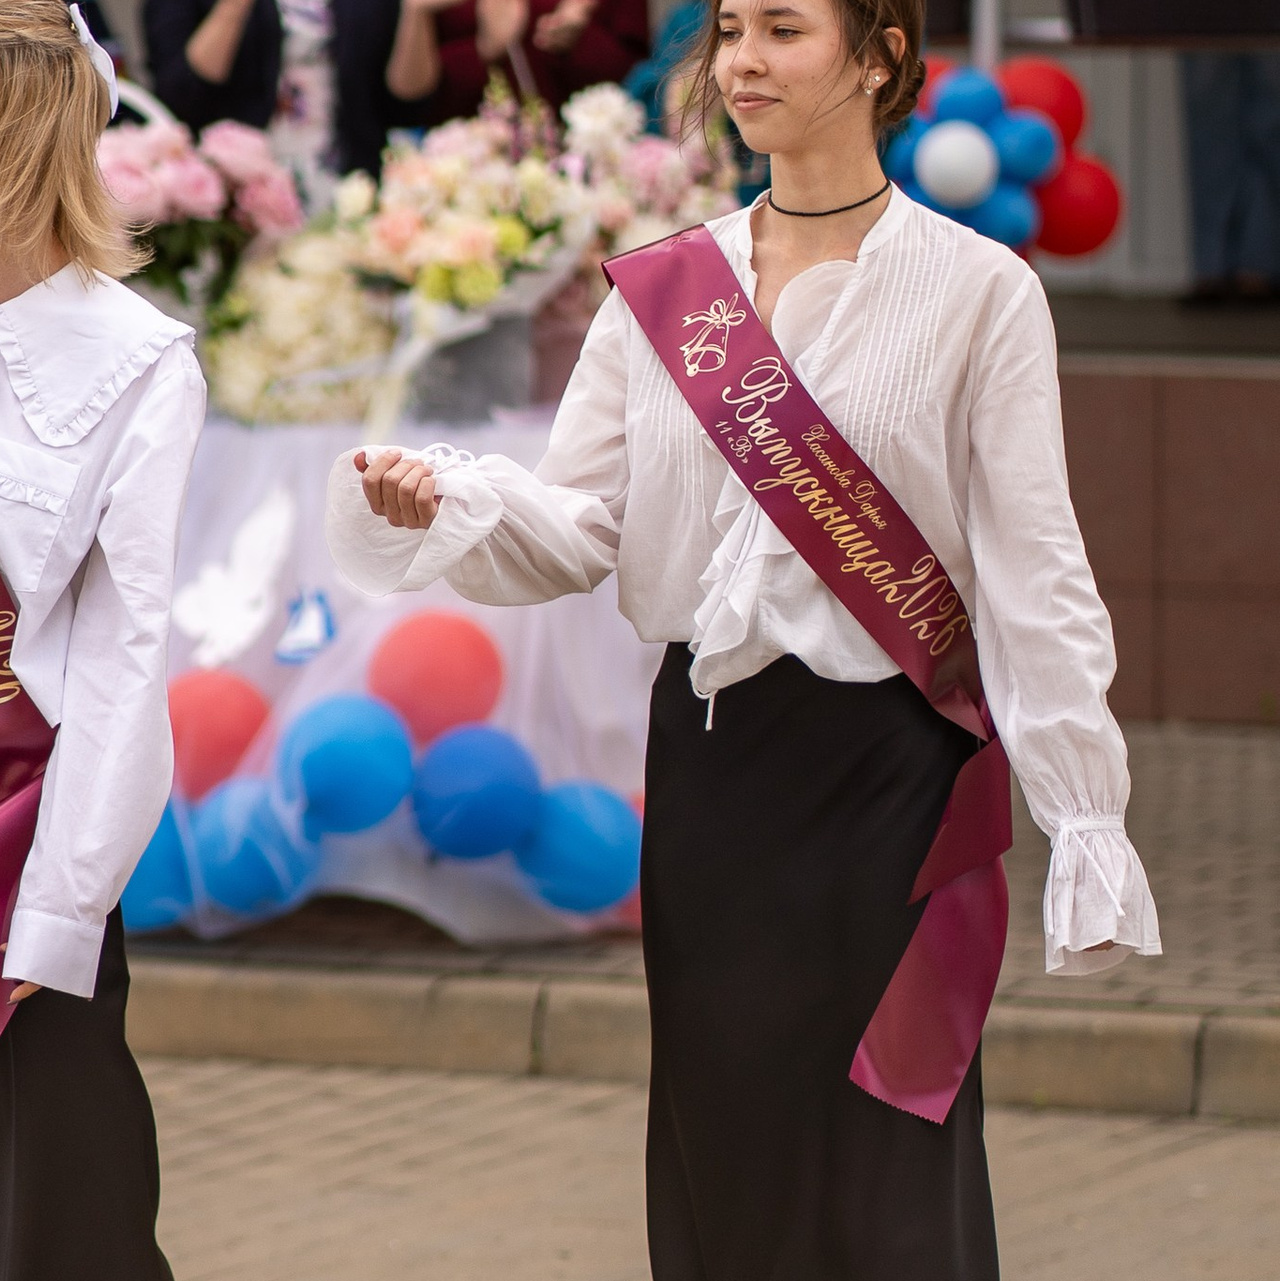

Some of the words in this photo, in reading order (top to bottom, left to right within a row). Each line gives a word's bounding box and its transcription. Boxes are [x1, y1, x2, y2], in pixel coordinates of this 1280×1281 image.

[715, 420, 733, 434] 11
[801, 423, 856, 489] Хасанова
[848, 480, 888, 530] Дарья
[721, 356, 896, 585] Выпускница
[877, 554, 968, 656] 2026
